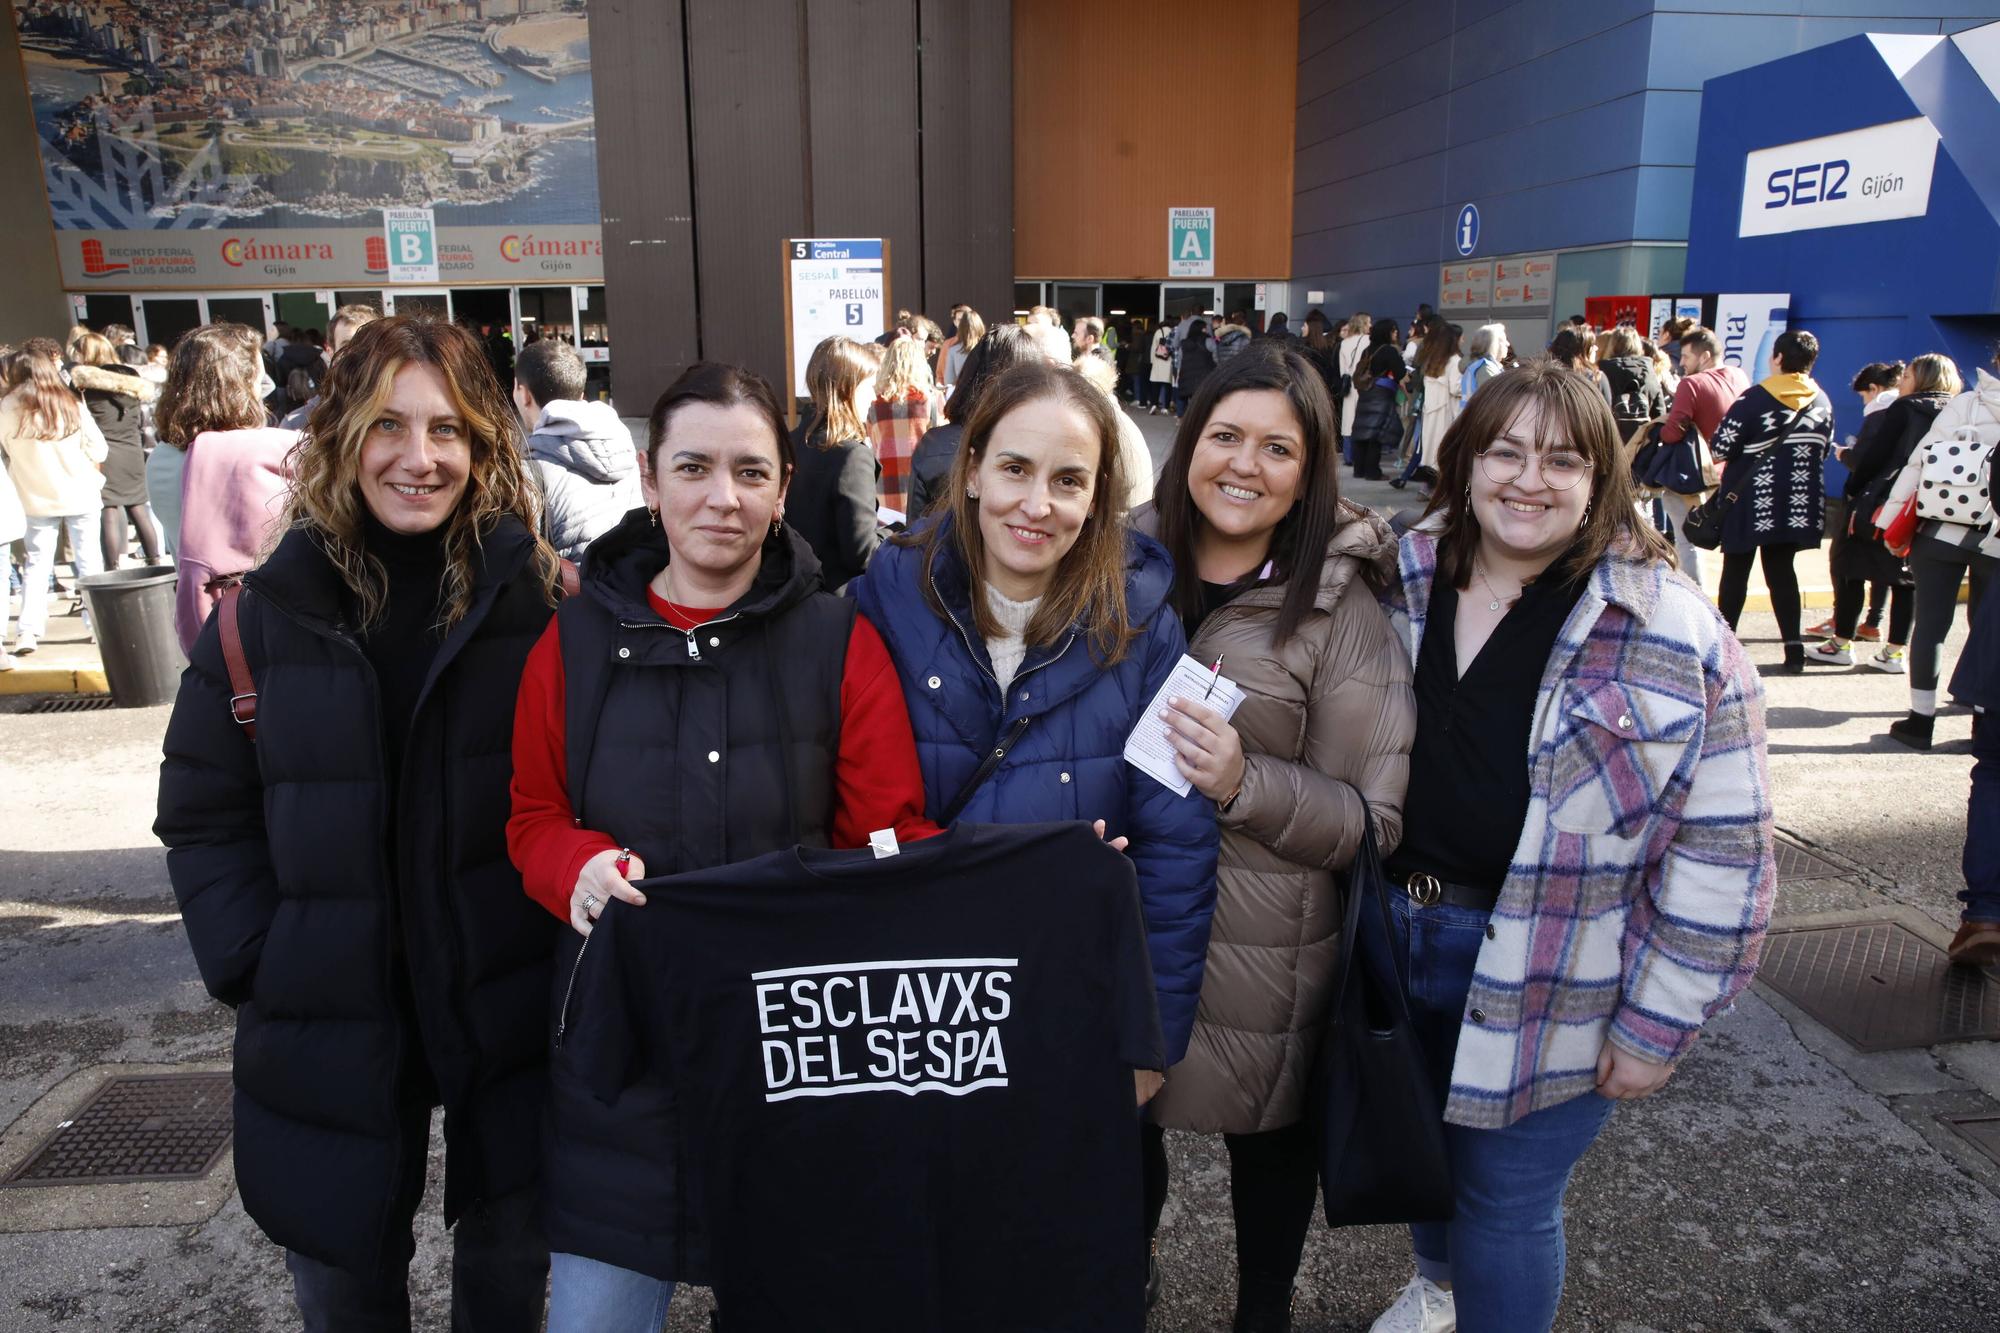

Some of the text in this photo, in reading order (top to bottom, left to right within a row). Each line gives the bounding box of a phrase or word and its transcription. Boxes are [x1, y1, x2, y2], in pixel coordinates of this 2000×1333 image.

[1765, 159, 1904, 209] SER Gijón
[391, 221, 429, 232] PUERTA
[1174, 219, 1208, 229] PUERTA
[400, 234, 423, 262] B
[438, 244, 473, 253] FERIAL
[796, 243, 807, 259] 5
[1180, 231, 1203, 258] A
[109, 247, 194, 257] RECINTO FERIAL
[222, 237, 334, 267] Cámara
[814, 248, 850, 259] Central
[132, 256, 196, 266] DE ASTURIAS
[438, 262, 474, 271] ADARO
[540, 259, 573, 273] Gijón
[133, 266, 197, 275] LUIS ADARO
[263, 263, 297, 277] Gijón
[799, 272, 831, 280] SESPA
[829, 286, 879, 299] PABELLÓN
[849, 304, 860, 323] 5
[1722, 313, 1747, 367] ona
[756, 971, 1012, 1034] ESCLAVXS
[761, 1026, 1008, 1089] DEL SESPA
